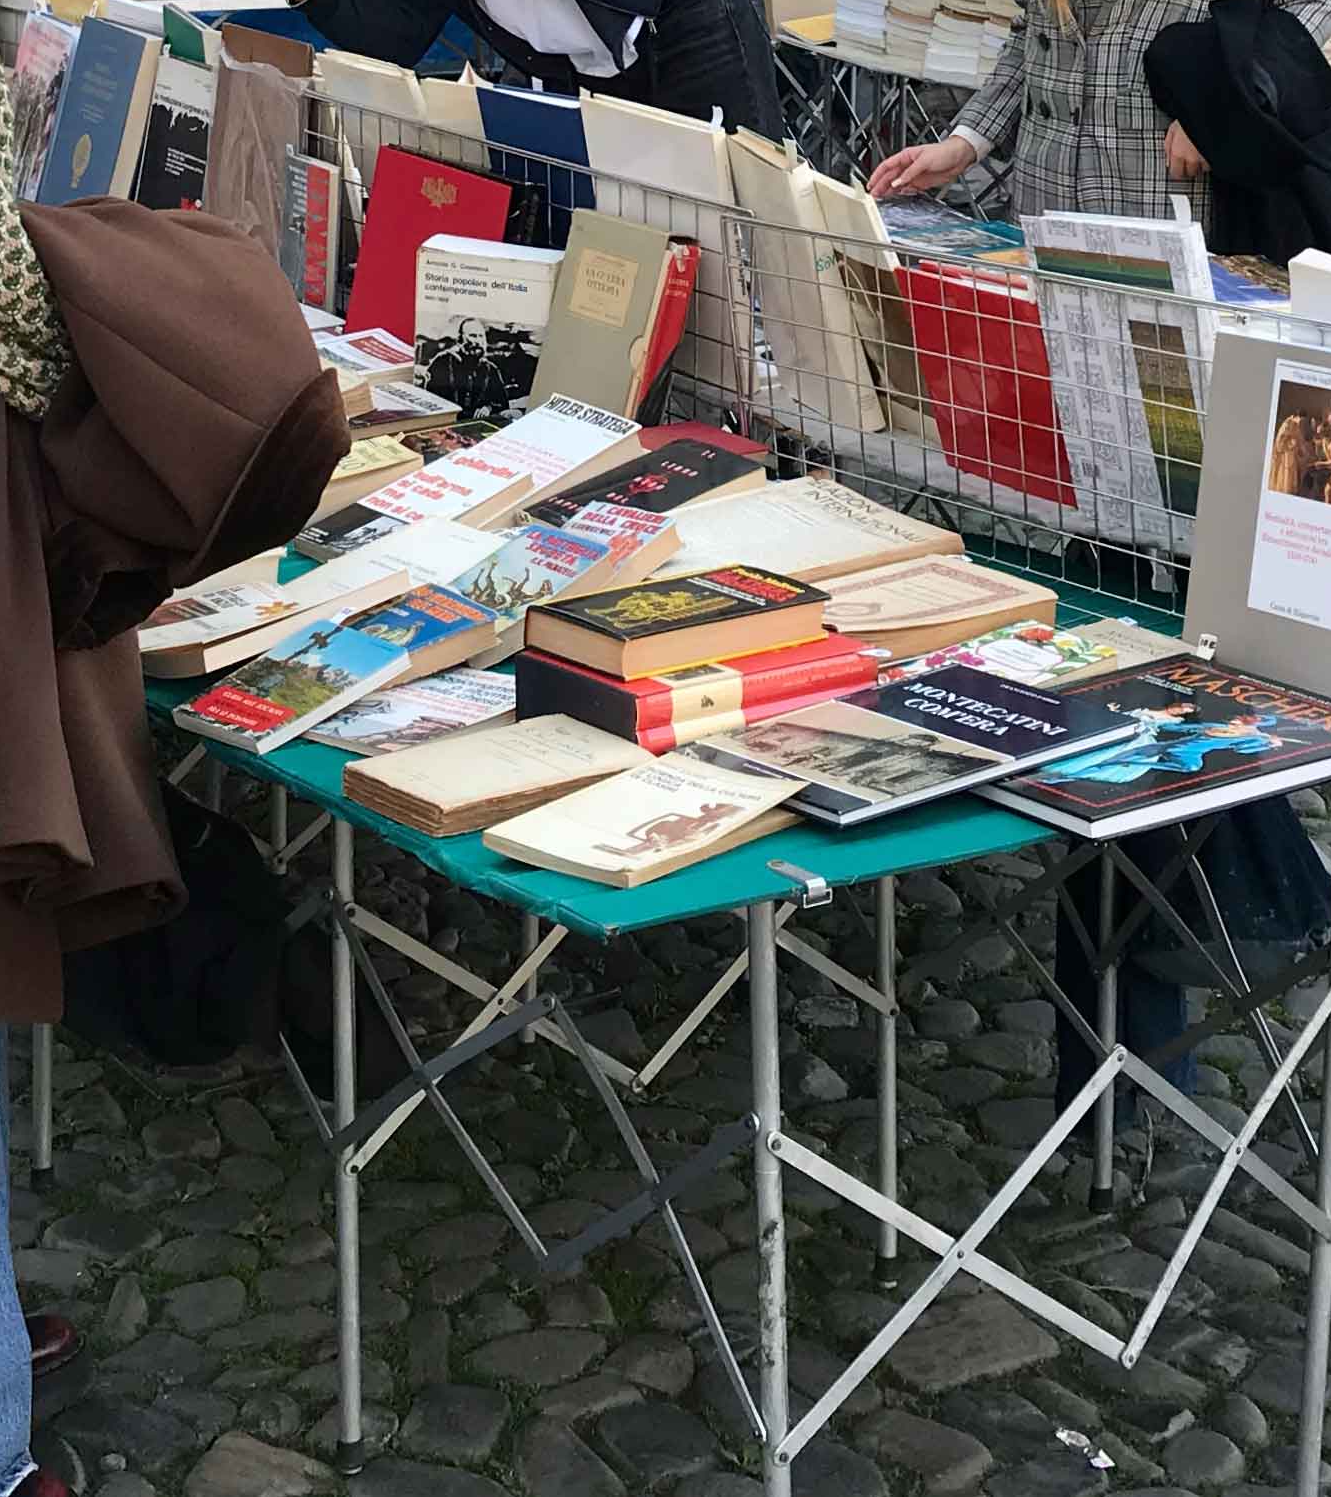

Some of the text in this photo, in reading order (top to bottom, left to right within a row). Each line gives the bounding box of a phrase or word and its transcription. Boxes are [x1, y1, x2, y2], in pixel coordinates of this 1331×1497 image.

[424, 272, 449, 283] Storia
[452, 277, 487, 288] popolare
[424, 283, 487, 298] contemporanea
[544, 395, 636, 436] HITLER STRATEGA
[581, 511, 664, 535] DELLA CROCE
[606, 504, 670, 525] CAVALIERI
[902, 681, 1069, 737] MONTECATINI
[903, 697, 1011, 737] COM'ERA
